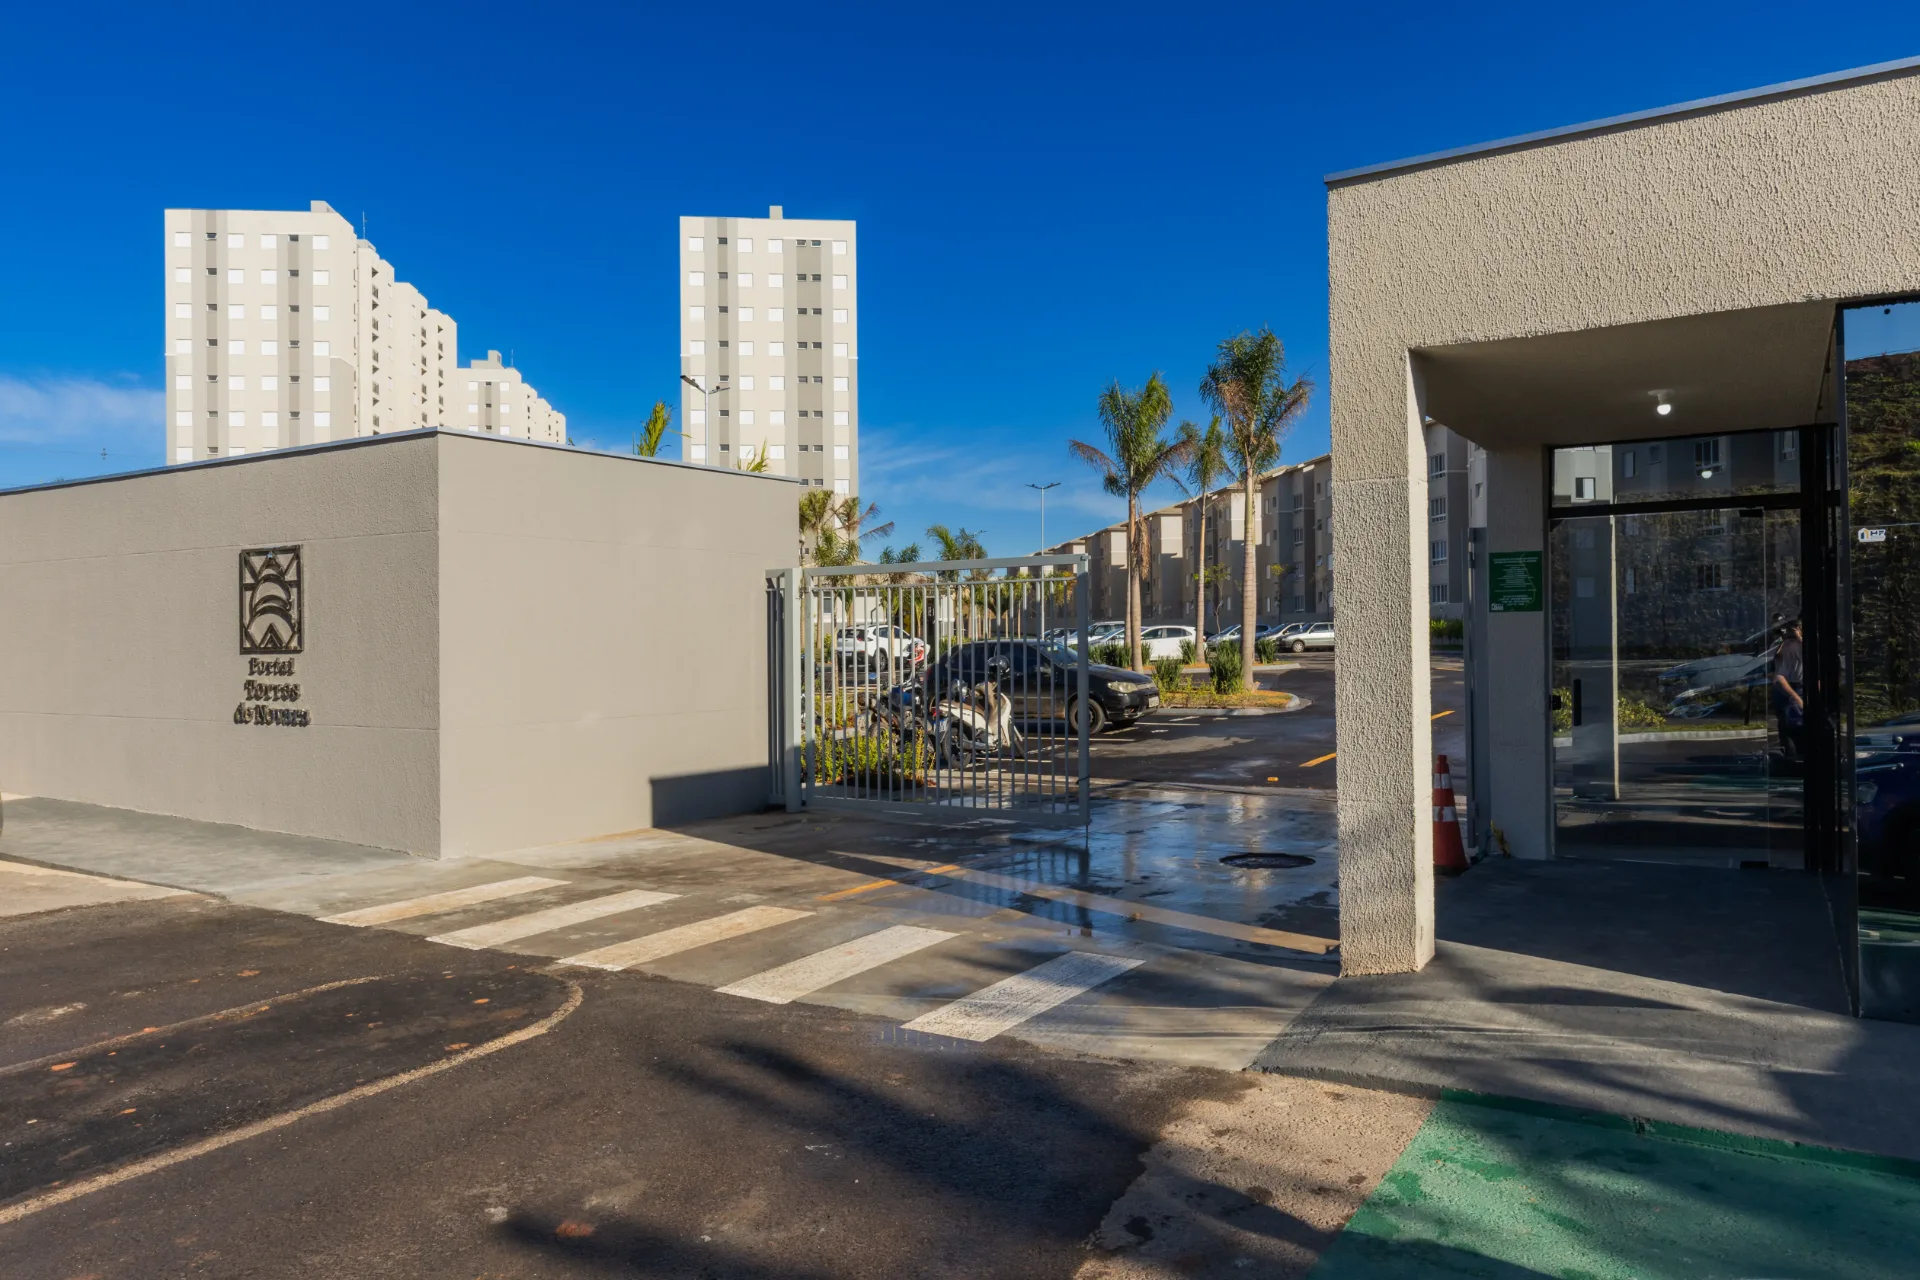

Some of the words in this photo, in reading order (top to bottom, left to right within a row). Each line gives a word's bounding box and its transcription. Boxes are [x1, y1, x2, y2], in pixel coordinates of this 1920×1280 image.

[248, 657, 295, 676] Portal
[244, 680, 301, 702] Torres
[234, 702, 252, 725] de
[254, 704, 311, 727] Novara
